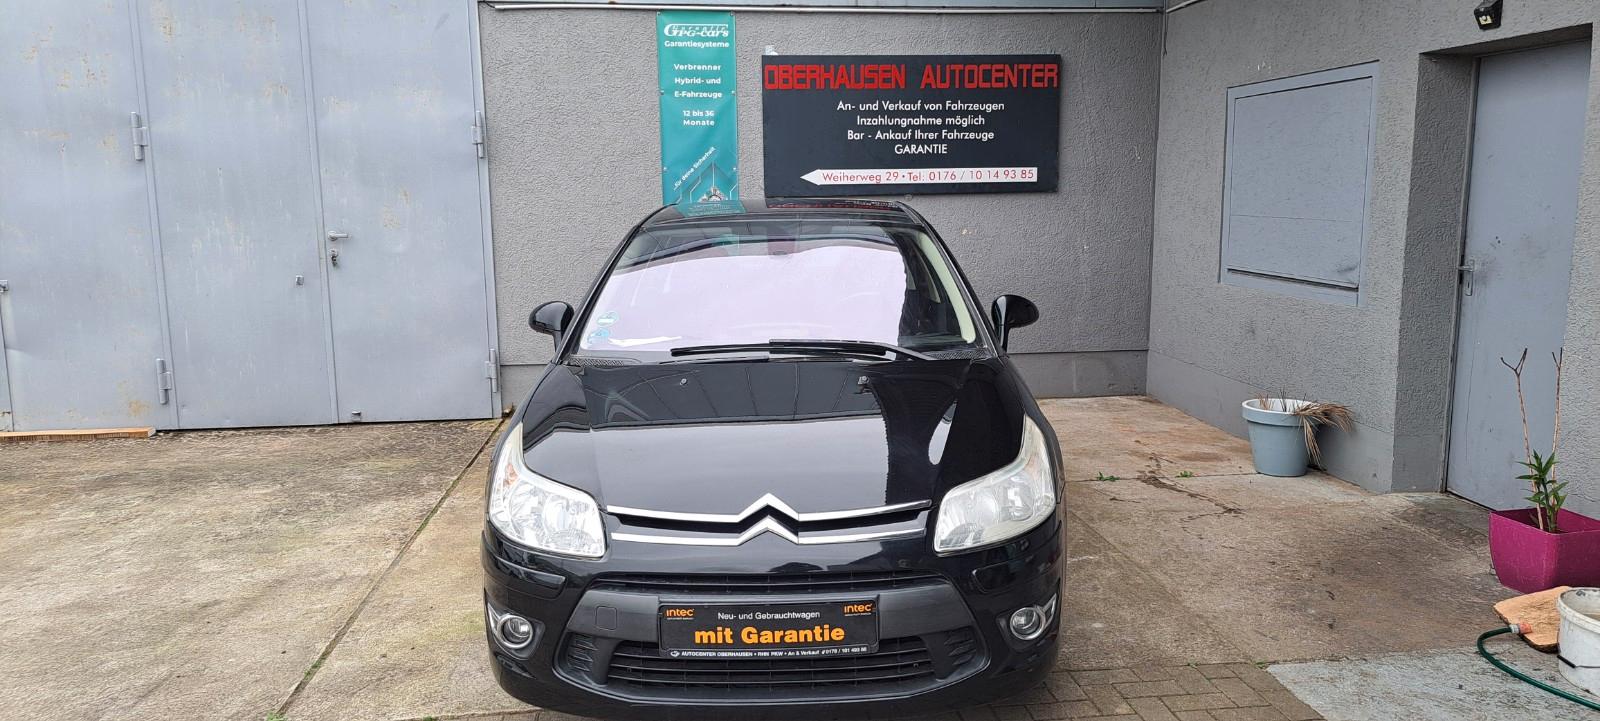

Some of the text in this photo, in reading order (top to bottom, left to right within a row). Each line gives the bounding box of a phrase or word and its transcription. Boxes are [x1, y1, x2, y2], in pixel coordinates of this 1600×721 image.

[664, 40, 730, 48] Garantiesysteme
[674, 76, 704, 85] Hybrid-
[764, 63, 1058, 89] OBERHAUSEN AUTOCENTER
[674, 90, 722, 99] E-Fahrzeuge
[837, 100, 856, 110] An-
[859, 100, 879, 110] und
[882, 100, 921, 110] Verkauf
[945, 100, 1005, 112] Fahrzeugen
[857, 115, 985, 127] Inzahlungnahme möglich
[847, 129, 865, 140] Bar
[875, 129, 912, 140] Ankauf
[915, 129, 939, 140] Ihrer
[942, 129, 995, 141] Fahrzeuge
[894, 144, 948, 154] GARANTIE
[692, 146, 716, 169] Sicherheit
[822, 171, 881, 183] Weiherweg
[886, 171, 899, 181] 29
[907, 171, 925, 181] Tel:
[929, 171, 957, 181] 0176
[969, 170, 982, 180] 10
[987, 170, 999, 180] 14
[1003, 169, 1017, 179] 93
[1020, 169, 1034, 179] 85
[666, 608, 693, 617] intec
[844, 604, 872, 614] intec
[717, 611, 820, 620] Neu- und Gebrauchtwagen
[695, 624, 845, 644] mit Garantie
